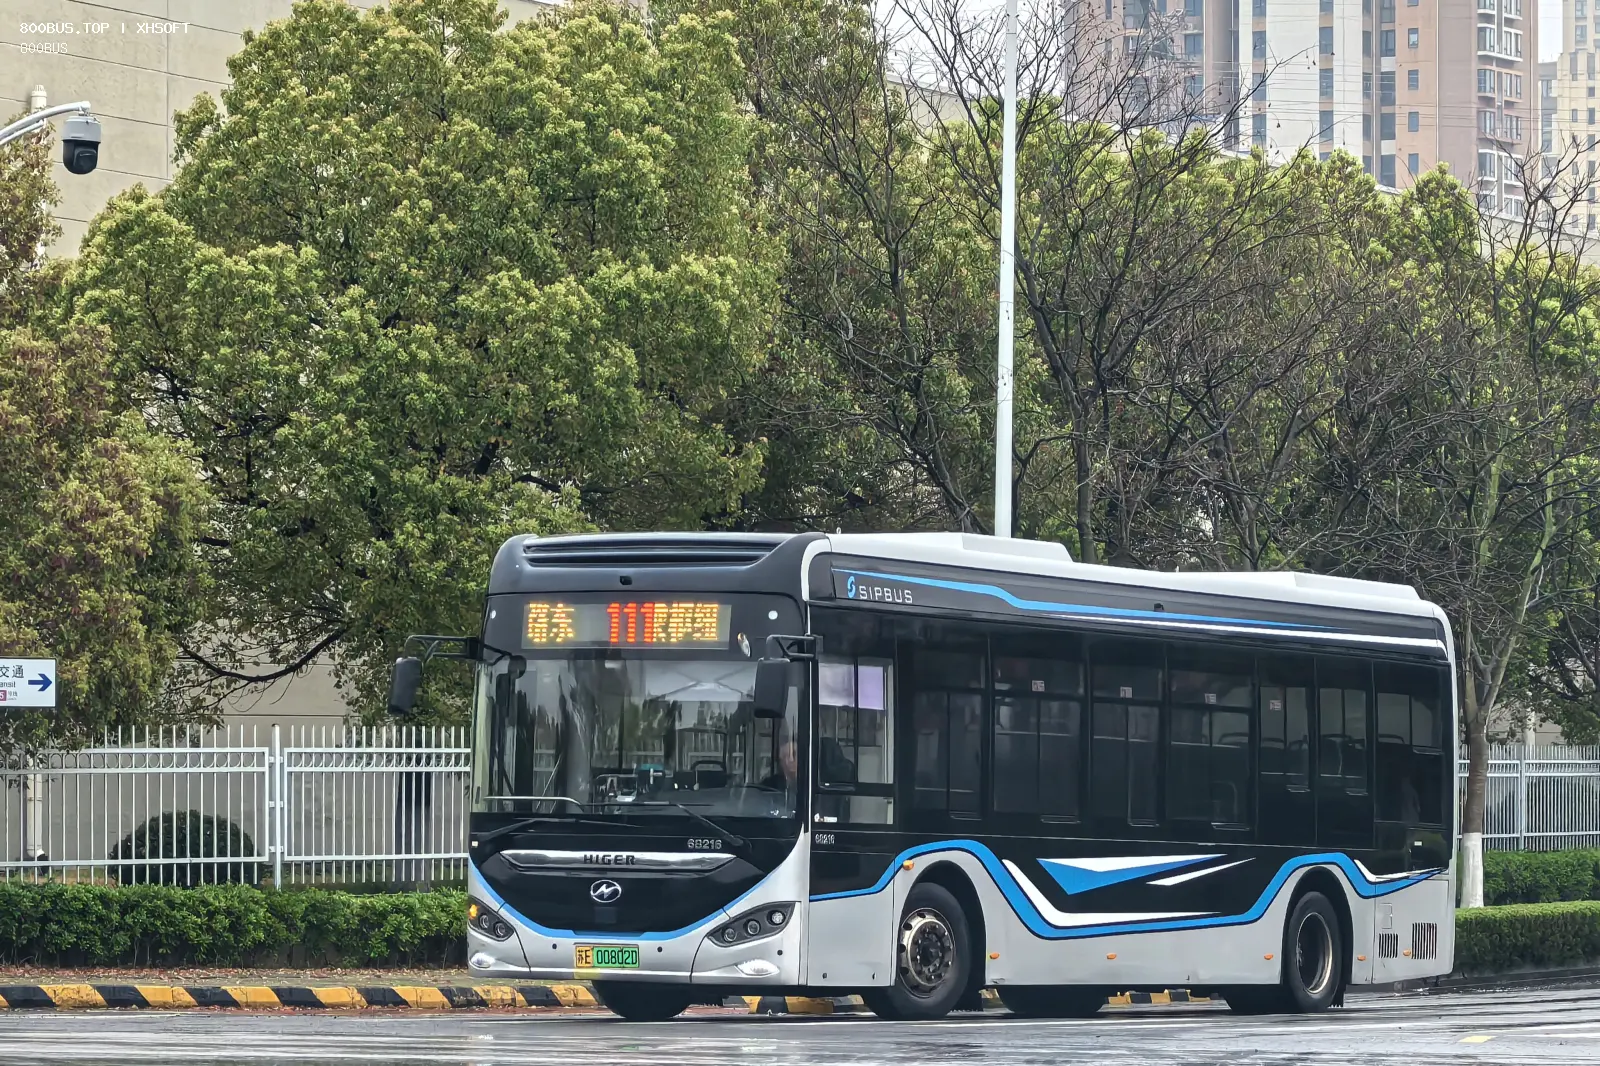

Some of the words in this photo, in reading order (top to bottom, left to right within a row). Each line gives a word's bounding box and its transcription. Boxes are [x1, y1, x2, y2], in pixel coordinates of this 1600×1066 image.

[859, 585, 913, 604] SIPBUS
[0, 664, 24, 679] 交通
[583, 854, 636, 865] HIGER
